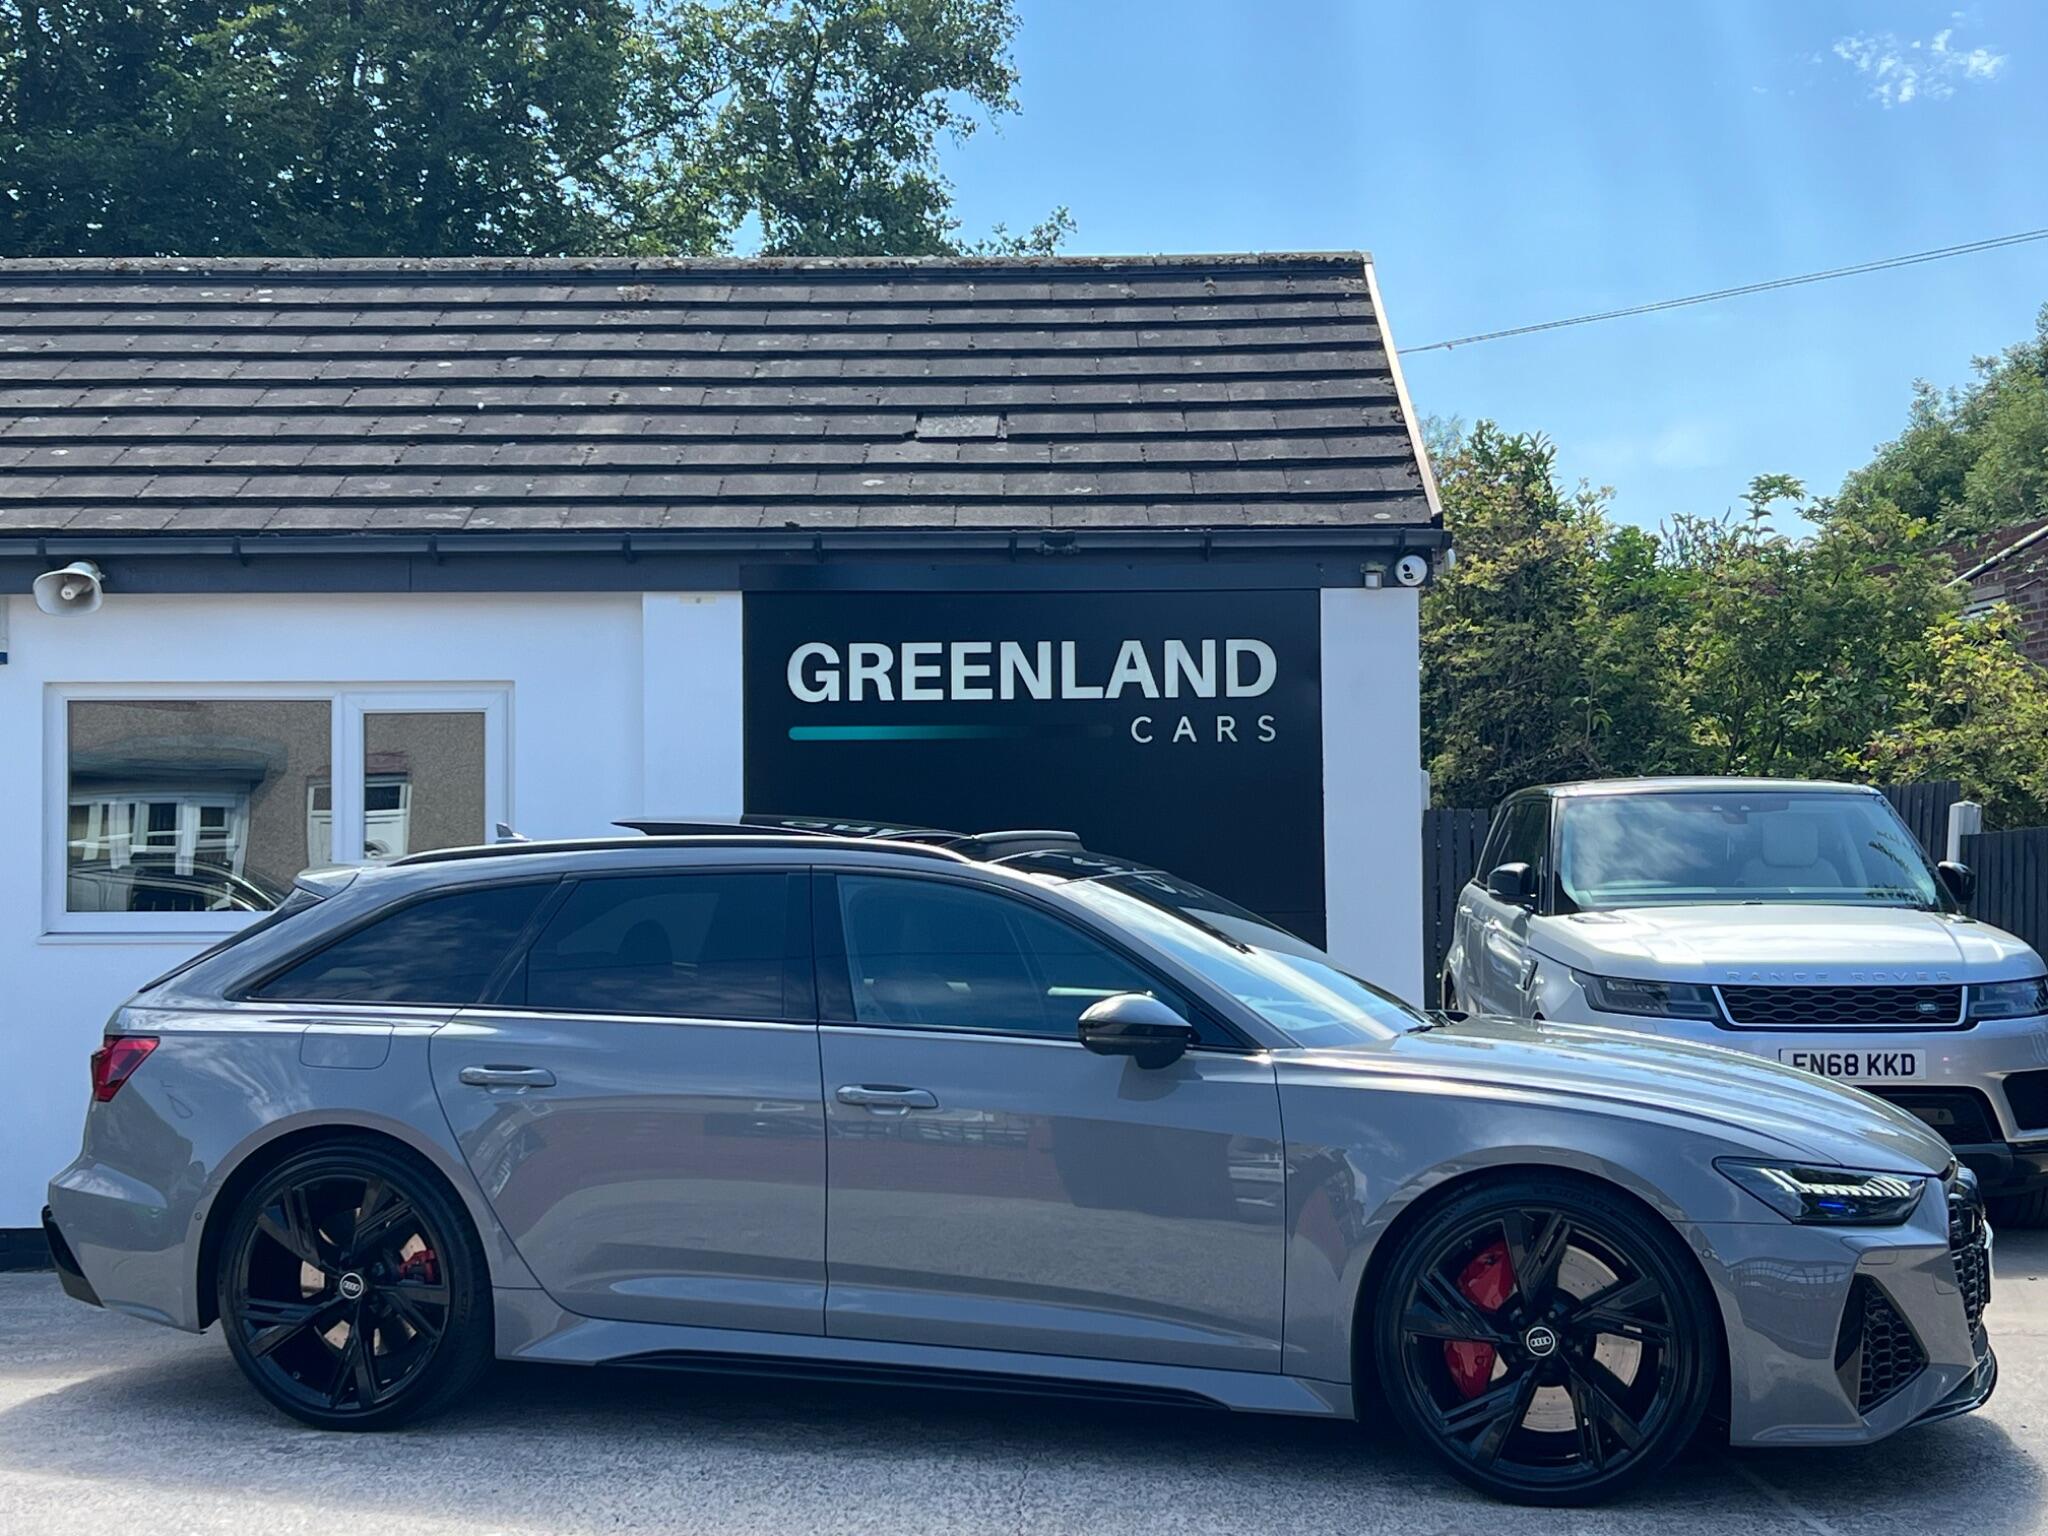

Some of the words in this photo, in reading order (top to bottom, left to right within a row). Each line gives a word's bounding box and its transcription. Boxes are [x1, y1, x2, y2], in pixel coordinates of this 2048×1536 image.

[786, 638, 1278, 702] GREENLAND
[1130, 714, 1277, 744] CARS
[1726, 971, 1830, 982] RANGE
[1851, 971, 1953, 982] ROVER
[1793, 1053, 1859, 1076] EN68
[1867, 1053, 1916, 1076] KKD
